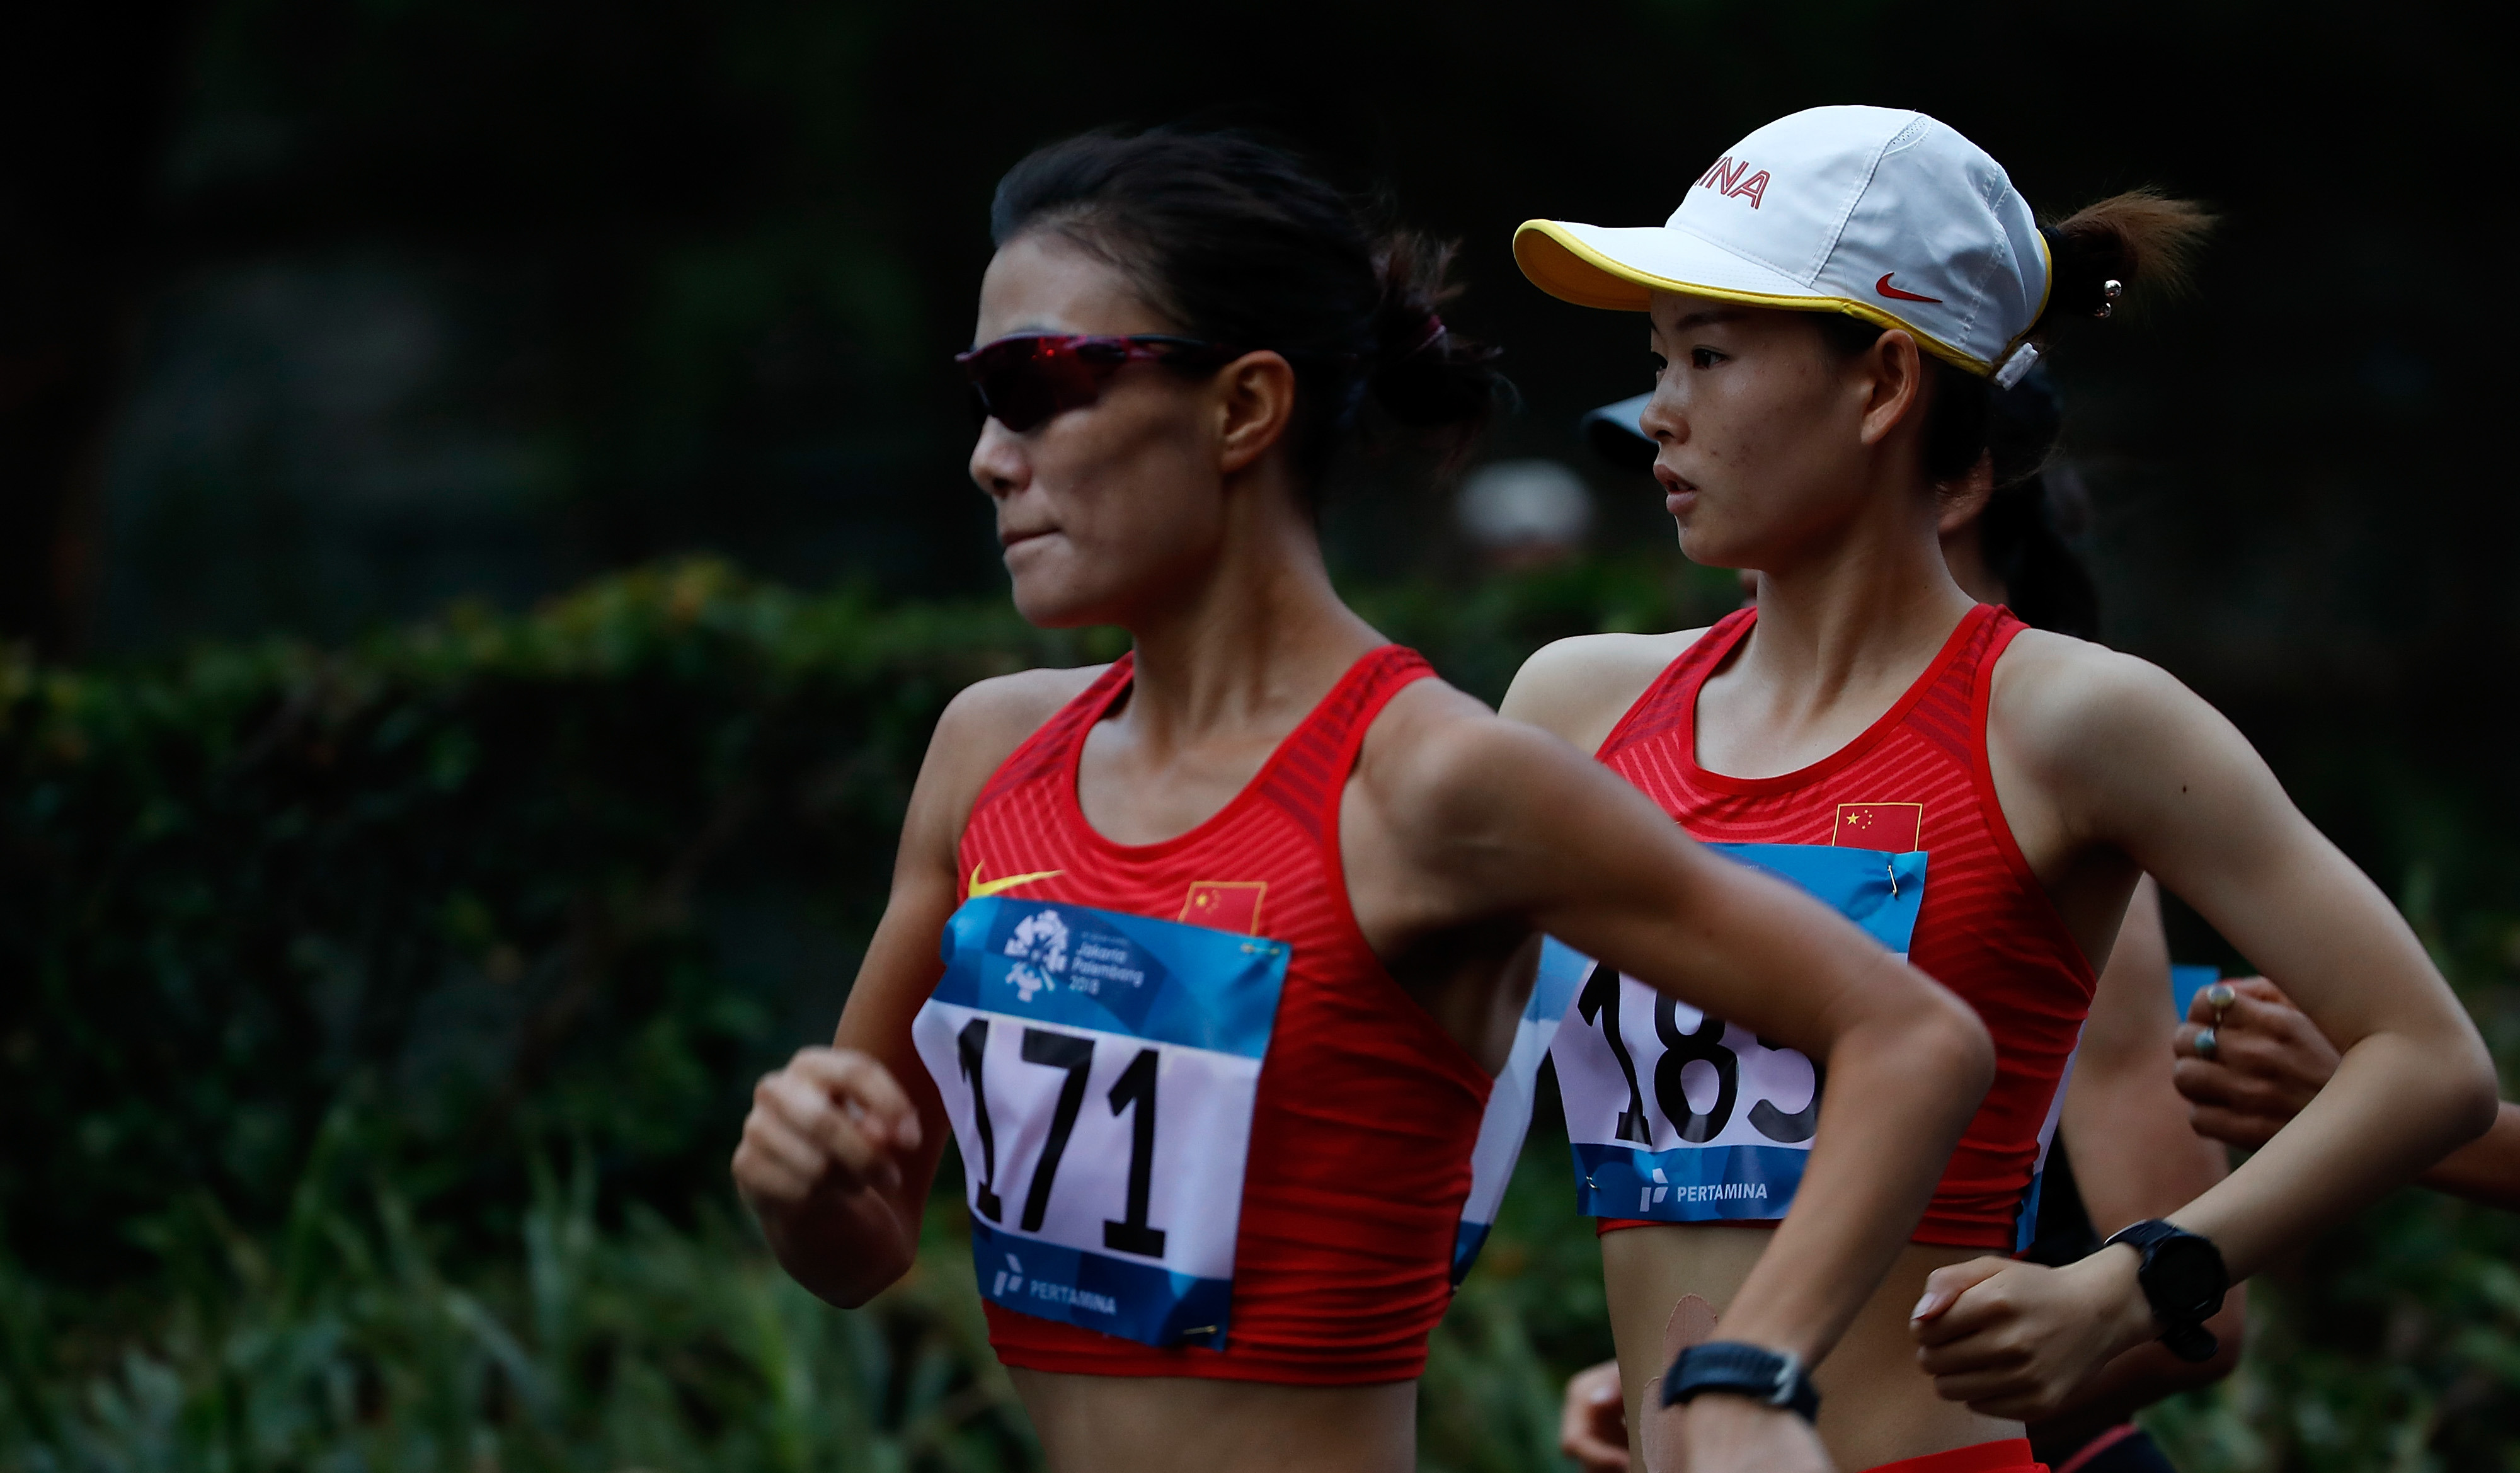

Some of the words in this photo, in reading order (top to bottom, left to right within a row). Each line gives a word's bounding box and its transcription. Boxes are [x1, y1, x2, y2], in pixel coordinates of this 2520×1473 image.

[958, 1017, 1166, 1259] 171
[1677, 1183, 1768, 1203] PERTAMINA
[1030, 1280, 1116, 1315] PERTAMINA
